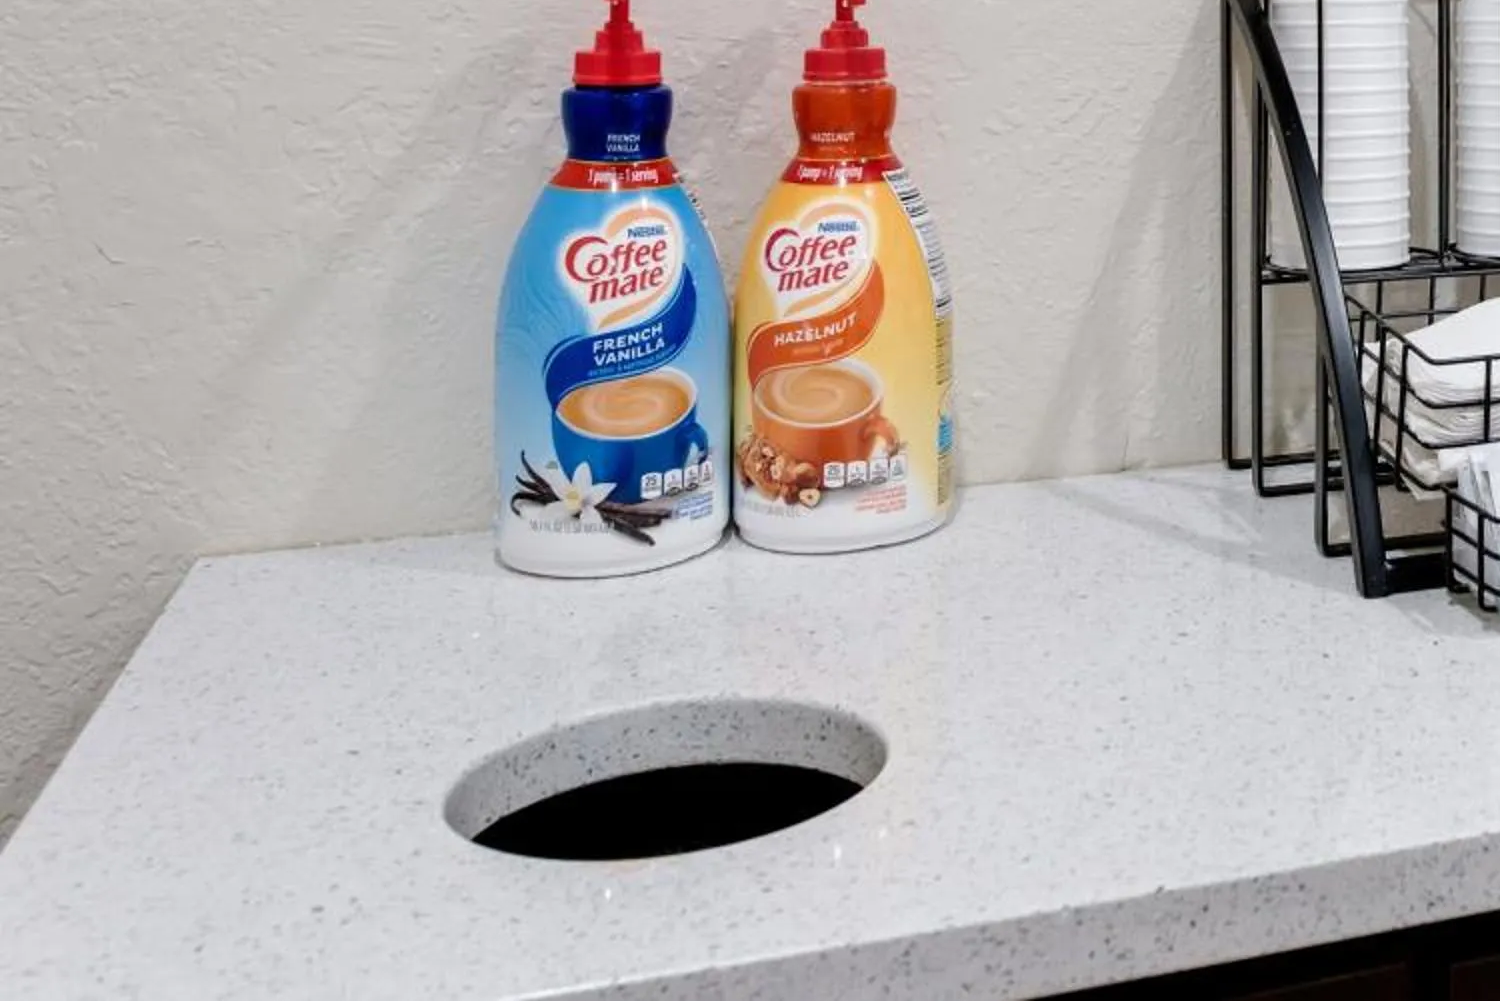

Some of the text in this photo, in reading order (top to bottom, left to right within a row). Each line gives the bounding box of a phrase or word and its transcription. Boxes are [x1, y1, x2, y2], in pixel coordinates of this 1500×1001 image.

[606, 134, 641, 143] FRENCH
[606, 144, 641, 152] VANILLA
[811, 131, 856, 144] HAZELNUT
[565, 235, 668, 282] Coffee
[764, 227, 857, 272] Coffee
[589, 265, 665, 303] mate
[777, 260, 849, 292] mate
[593, 322, 664, 354] FRENCH
[774, 310, 857, 348] HAZELNUT
[593, 337, 665, 367] VANILLA
